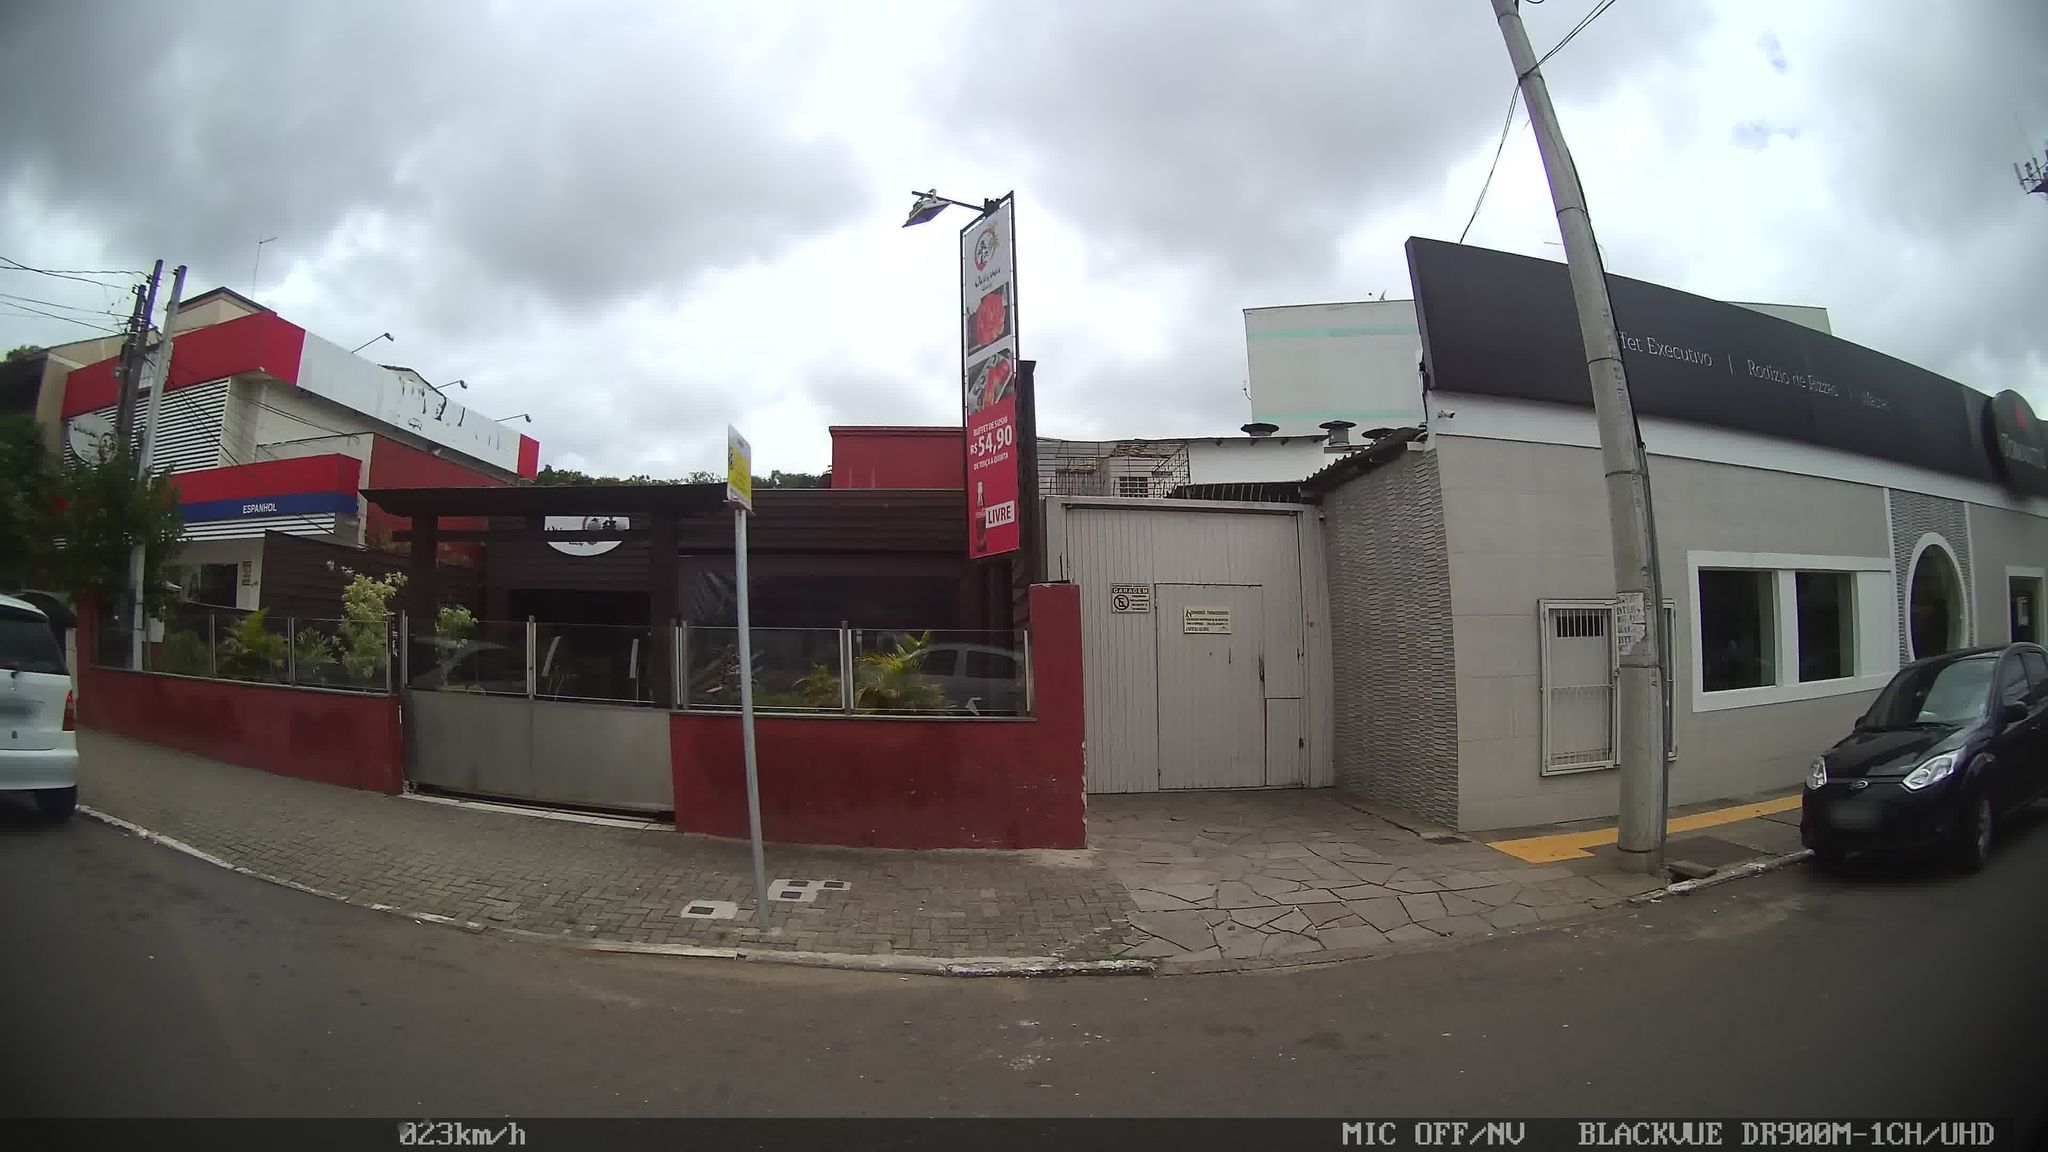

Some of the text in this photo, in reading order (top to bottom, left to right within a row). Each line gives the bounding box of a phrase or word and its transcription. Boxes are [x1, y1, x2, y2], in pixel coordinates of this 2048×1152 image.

[1646, 336, 1713, 367] Executivo
[242, 502, 278, 514] ESPANHOL
[988, 505, 1011, 524] LIVRE
